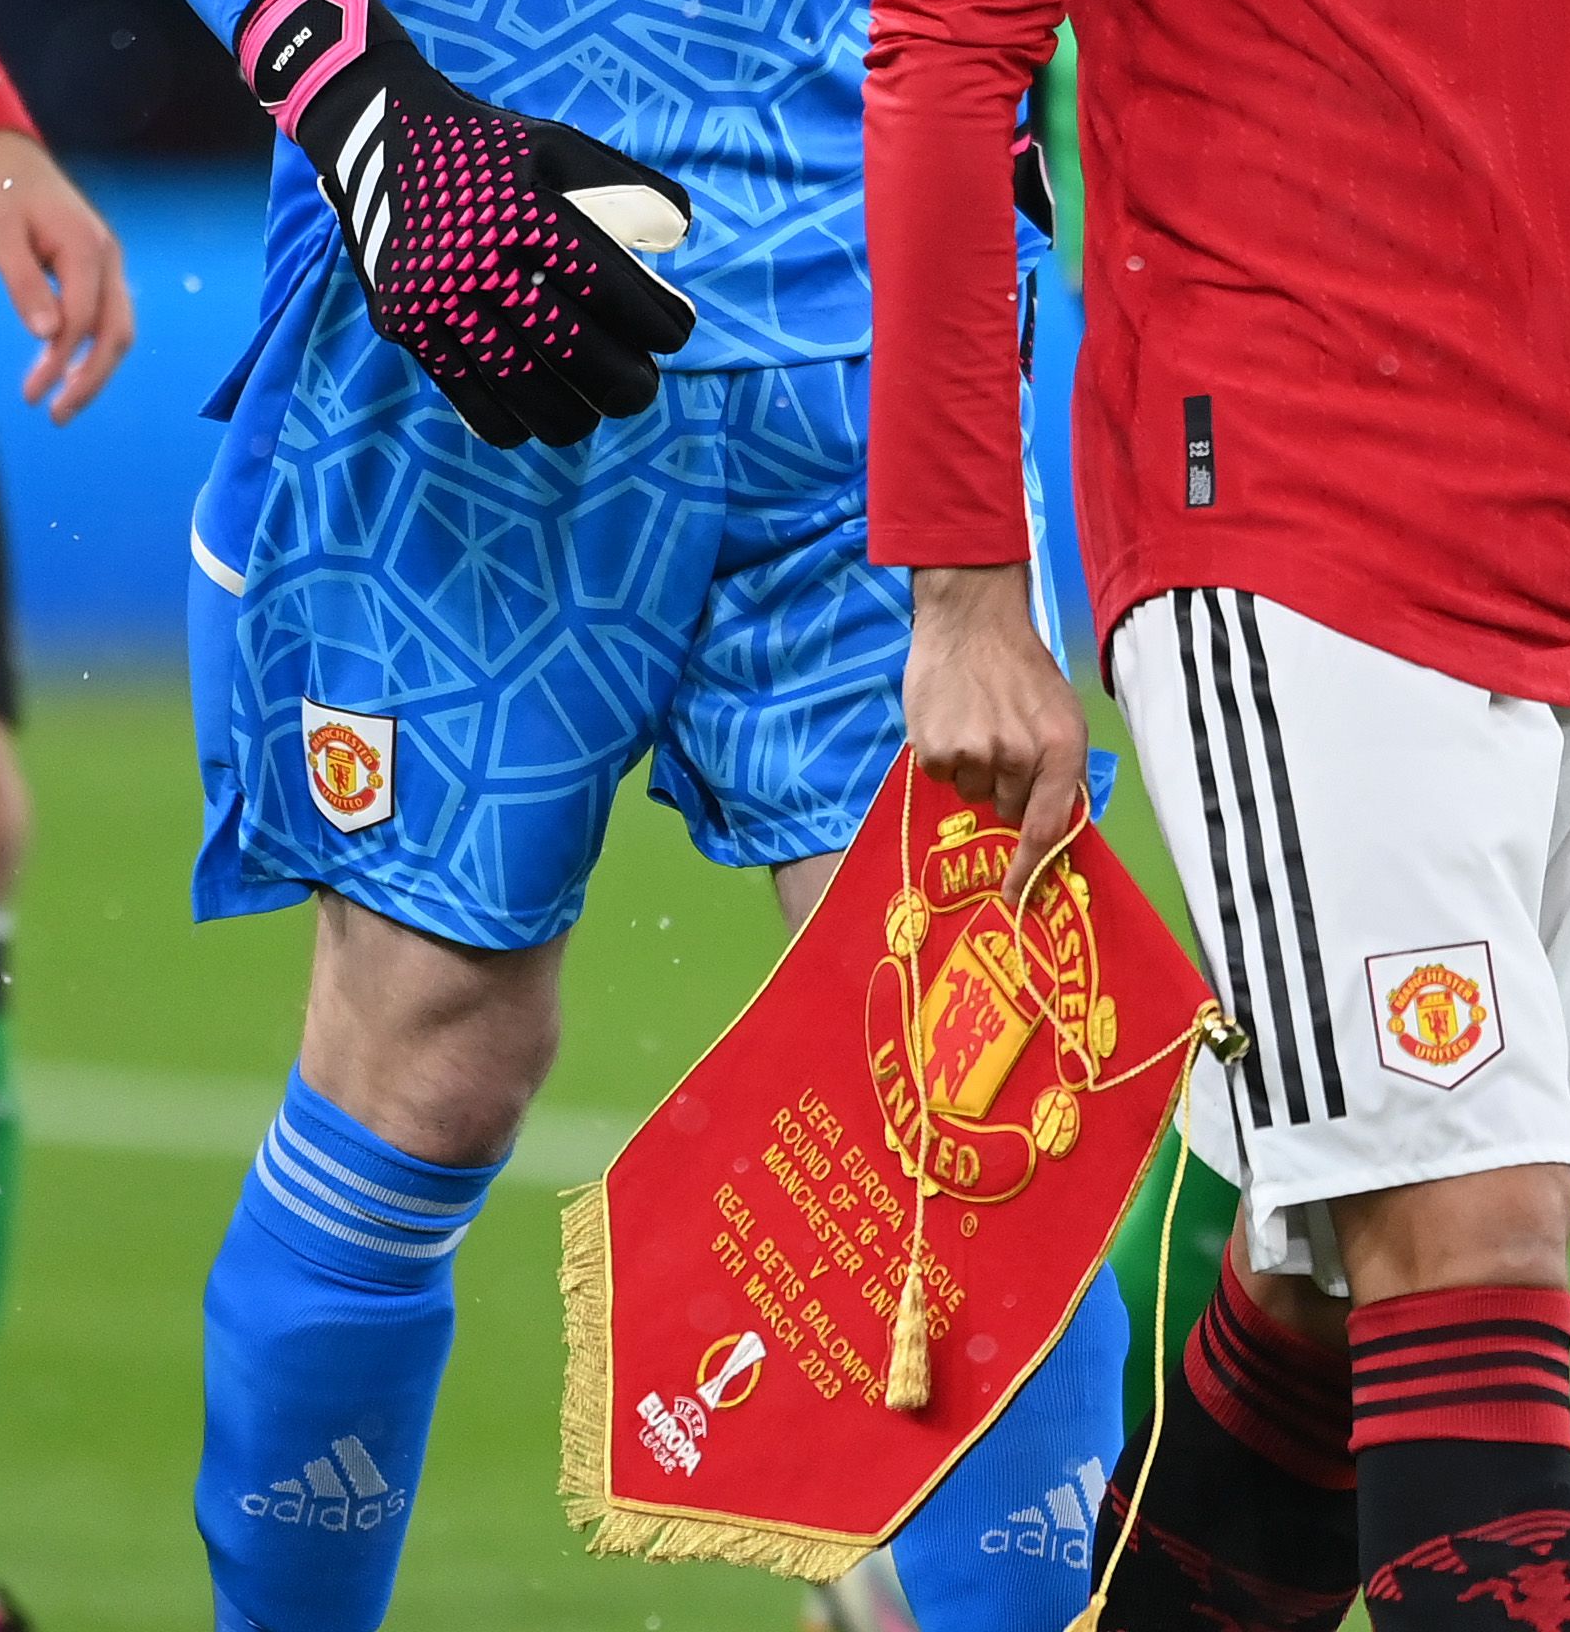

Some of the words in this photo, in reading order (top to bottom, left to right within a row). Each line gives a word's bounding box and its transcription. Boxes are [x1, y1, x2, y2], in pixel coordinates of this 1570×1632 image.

[272, 44, 295, 72] GEA
[292, 26, 312, 48] DE
[322, 787, 363, 809] UNITED
[940, 845, 1087, 1055] MANHESTER
[761, 1143, 864, 1278] MANCHESTER
[771, 1107, 831, 1181] ROUND
[829, 1183, 859, 1212] OF
[854, 1217, 879, 1246] 16
[798, 1087, 844, 1150] UEFA
[840, 1144, 906, 1232] EUROPA
[713, 1183, 756, 1242] REAL
[754, 1237, 805, 1302] BETIS
[810, 1256, 829, 1279] V
[711, 1231, 747, 1277] 9TH
[743, 1273, 804, 1352] MARCH
[798, 1349, 843, 1400] 2023
[636, 1390, 701, 1478] EUROPA
[241, 1489, 406, 1532] adidas
